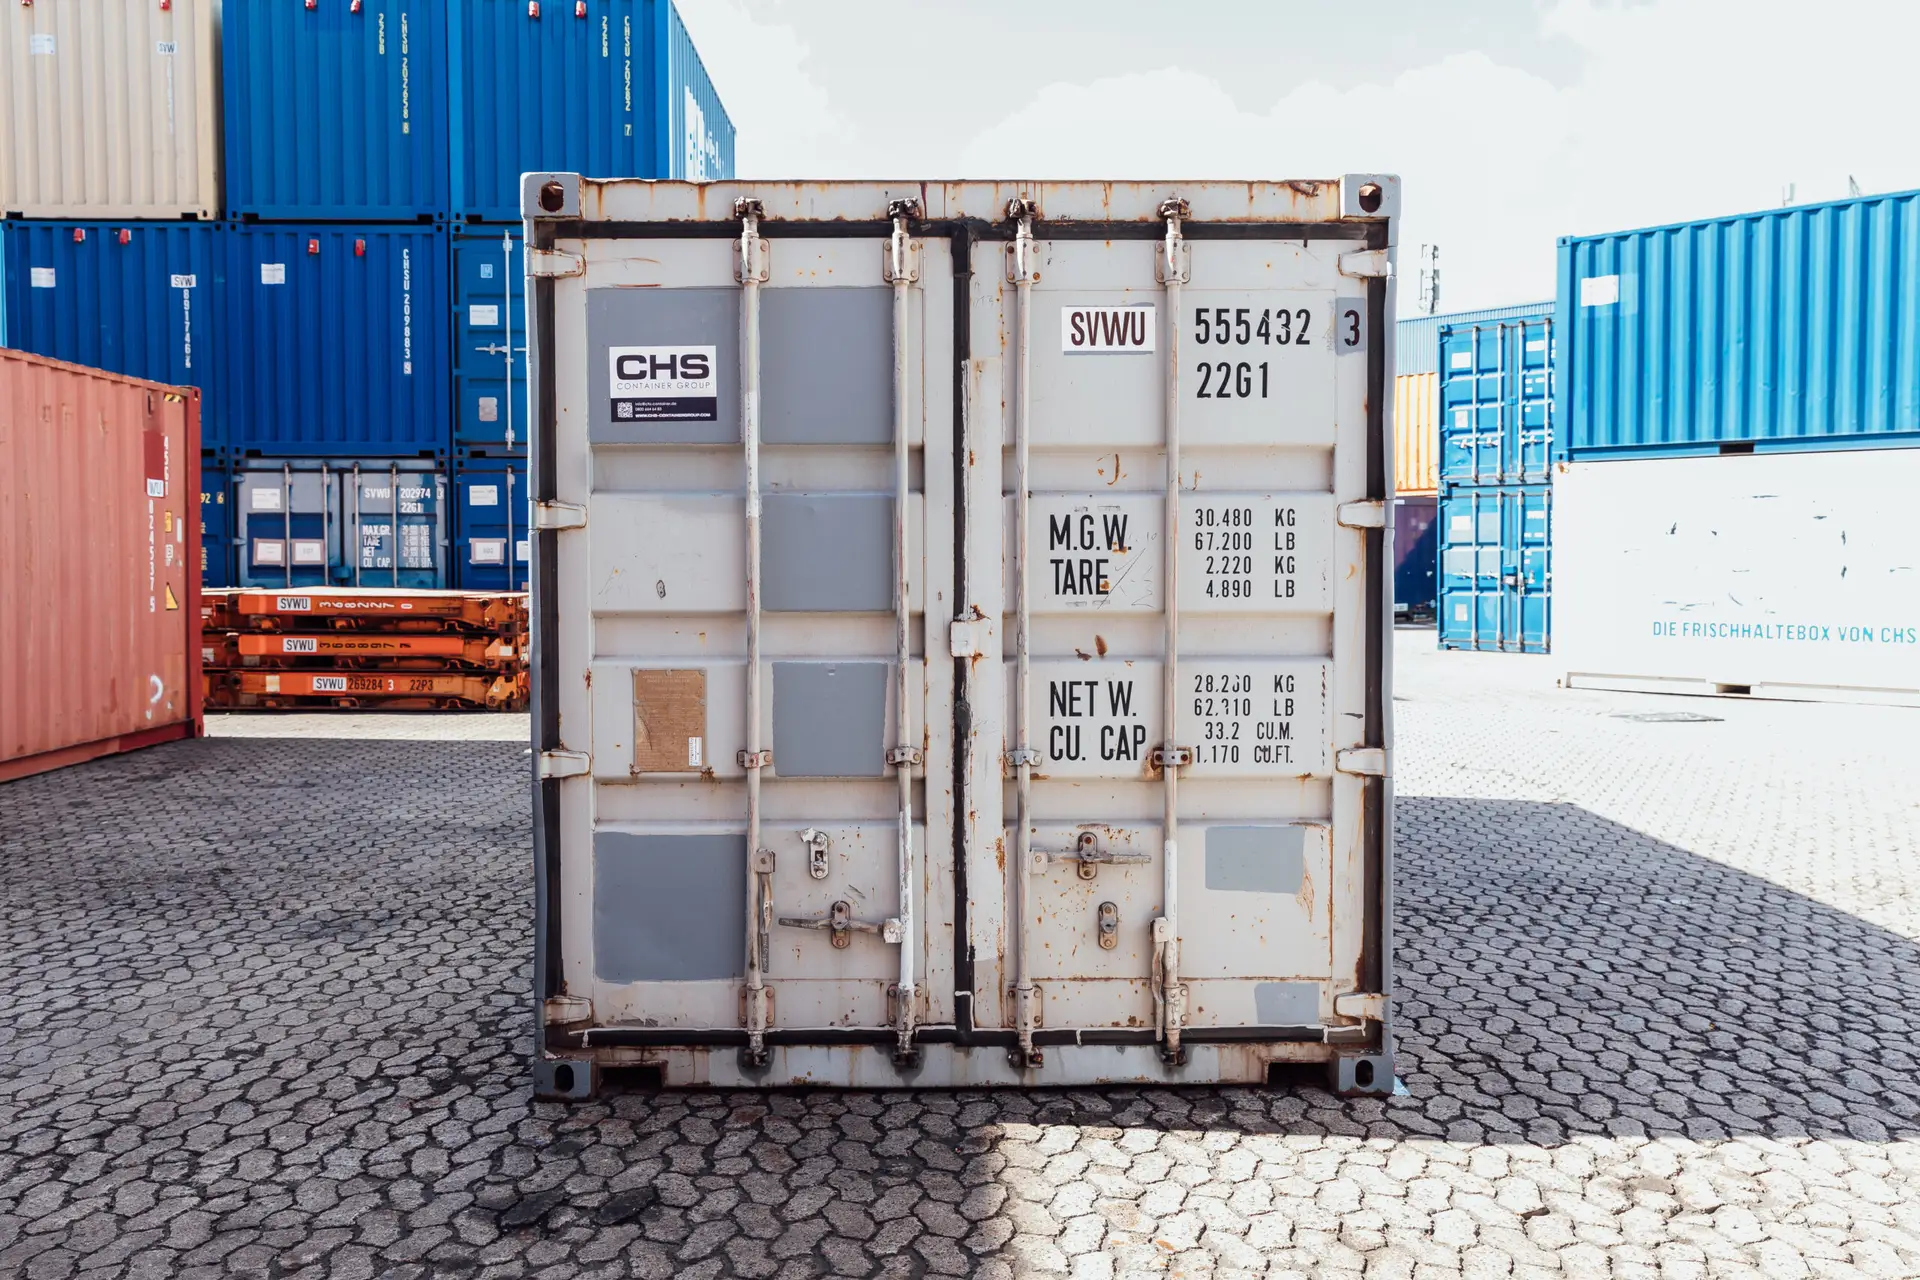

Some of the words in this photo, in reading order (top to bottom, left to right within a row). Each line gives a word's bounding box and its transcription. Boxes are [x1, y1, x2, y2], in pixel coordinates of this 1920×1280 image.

[1071, 311, 1145, 346] SVWU
[1195, 308, 1311, 345] 555432
[1344, 309, 1360, 346] 3
[616, 354, 710, 380] CHS
[616, 382, 672, 390] CONTAINER
[1196, 362, 1268, 398] 22G1
[1195, 508, 1252, 527] 30,480
[1275, 508, 1296, 527] KG
[1050, 514, 1132, 551] M.G.W.
[1195, 532, 1252, 551] 67,200
[1274, 532, 1296, 551] LB
[1206, 556, 1252, 575] 2,220
[1275, 556, 1296, 575] KG
[1050, 559, 1109, 595] TARE
[1206, 580, 1252, 598] 4,890
[1274, 580, 1296, 598] LB
[280, 598, 308, 609] SVWU
[319, 601, 395, 609] 368227
[1653, 621, 1677, 637] DIE
[1682, 622, 1830, 641] FRISCHHALTEBOX
[1838, 626, 1874, 642] VON
[1881, 627, 1917, 643] CHS
[286, 639, 314, 650] SVWU
[316, 678, 344, 689] SVWU
[348, 679, 383, 690] 269284
[388, 679, 395, 690] 3
[410, 680, 434, 691] 22P3
[1274, 674, 1295, 693] KG
[1050, 681, 1098, 717] NET
[1108, 681, 1137, 716] W.
[1273, 699, 1295, 716] LB
[1205, 721, 1239, 740] 33.2
[1256, 722, 1294, 740] CU.M.
[1050, 725, 1086, 761] CU.
[1195, 745, 1239, 763] 1,170
[1254, 745, 1293, 763] CU.FT.
